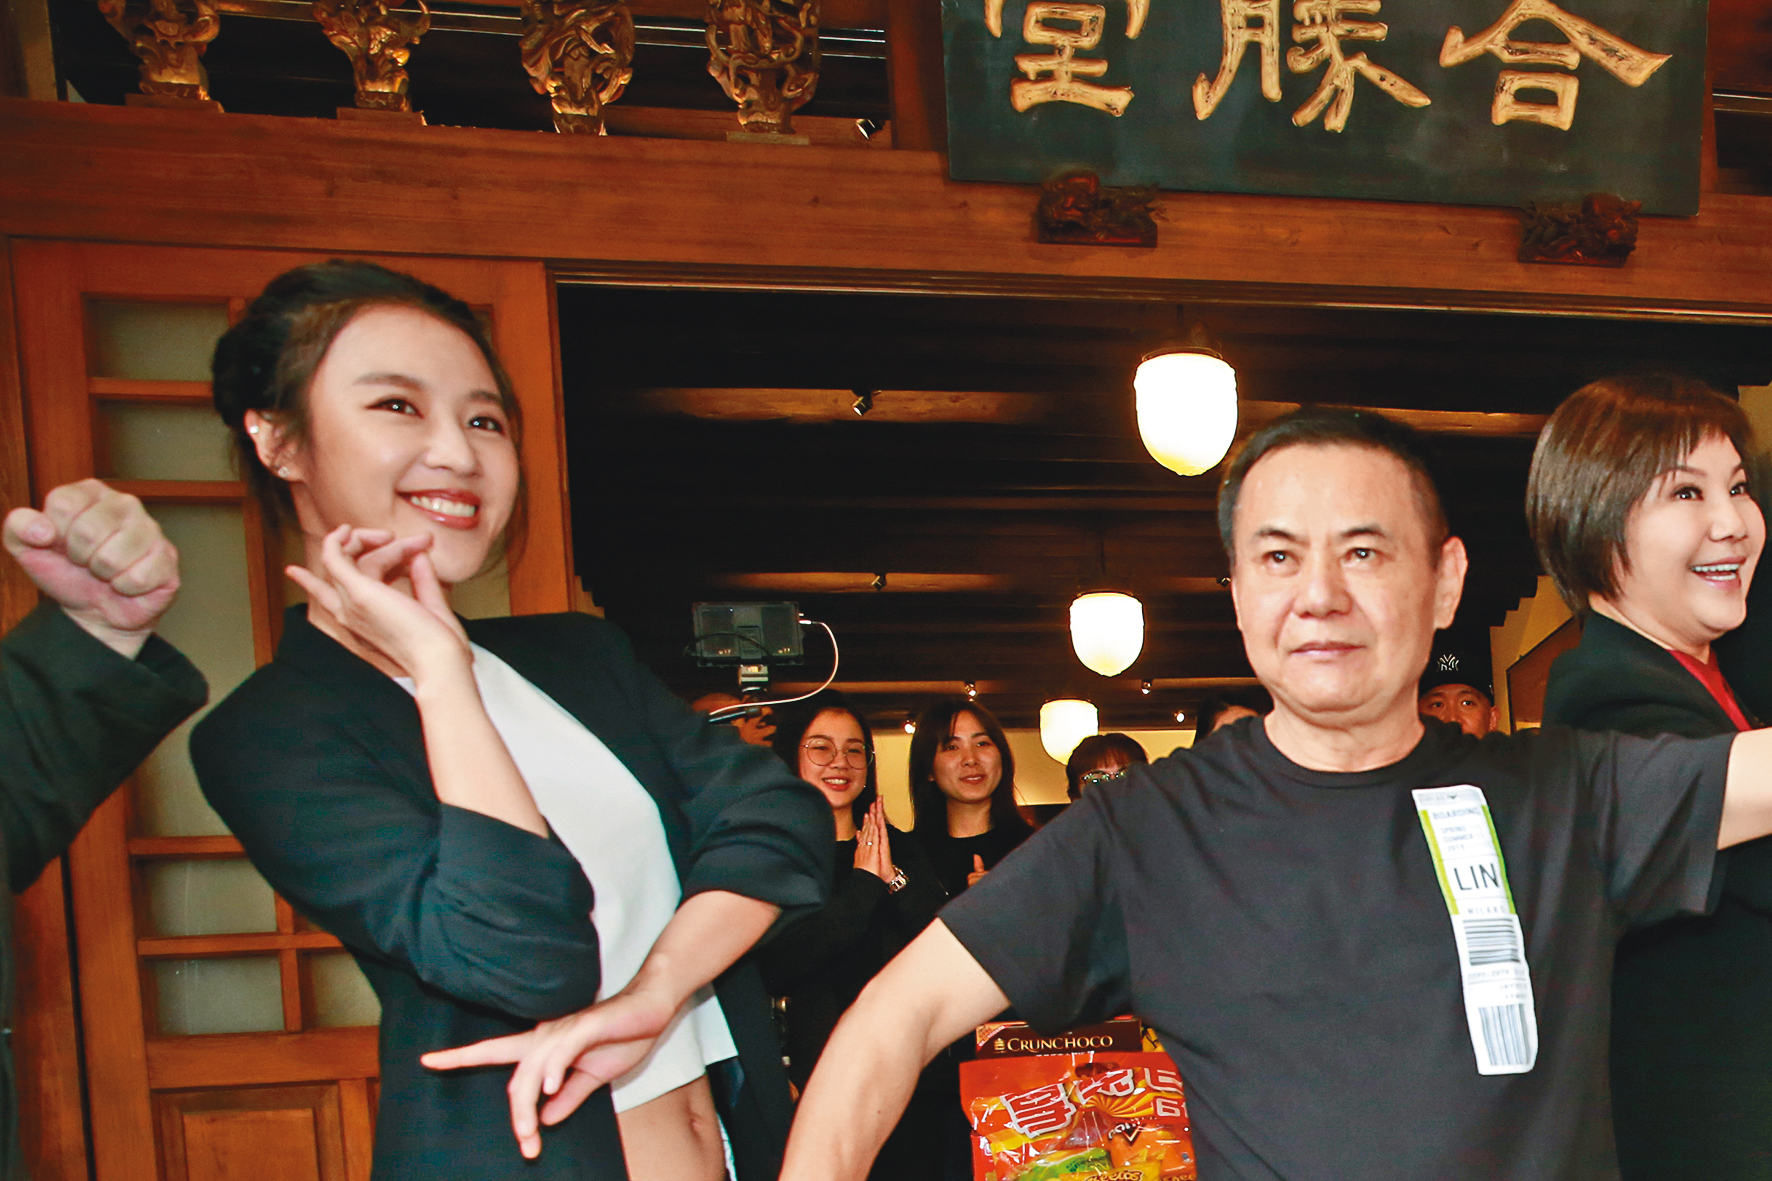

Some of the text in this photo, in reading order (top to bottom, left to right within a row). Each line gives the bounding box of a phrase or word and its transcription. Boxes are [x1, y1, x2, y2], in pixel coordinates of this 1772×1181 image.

[985, 0, 1673, 133] 合勝堂
[1453, 863, 1500, 891] LIN
[1007, 1035, 1113, 1052] CRUNCHOCO
